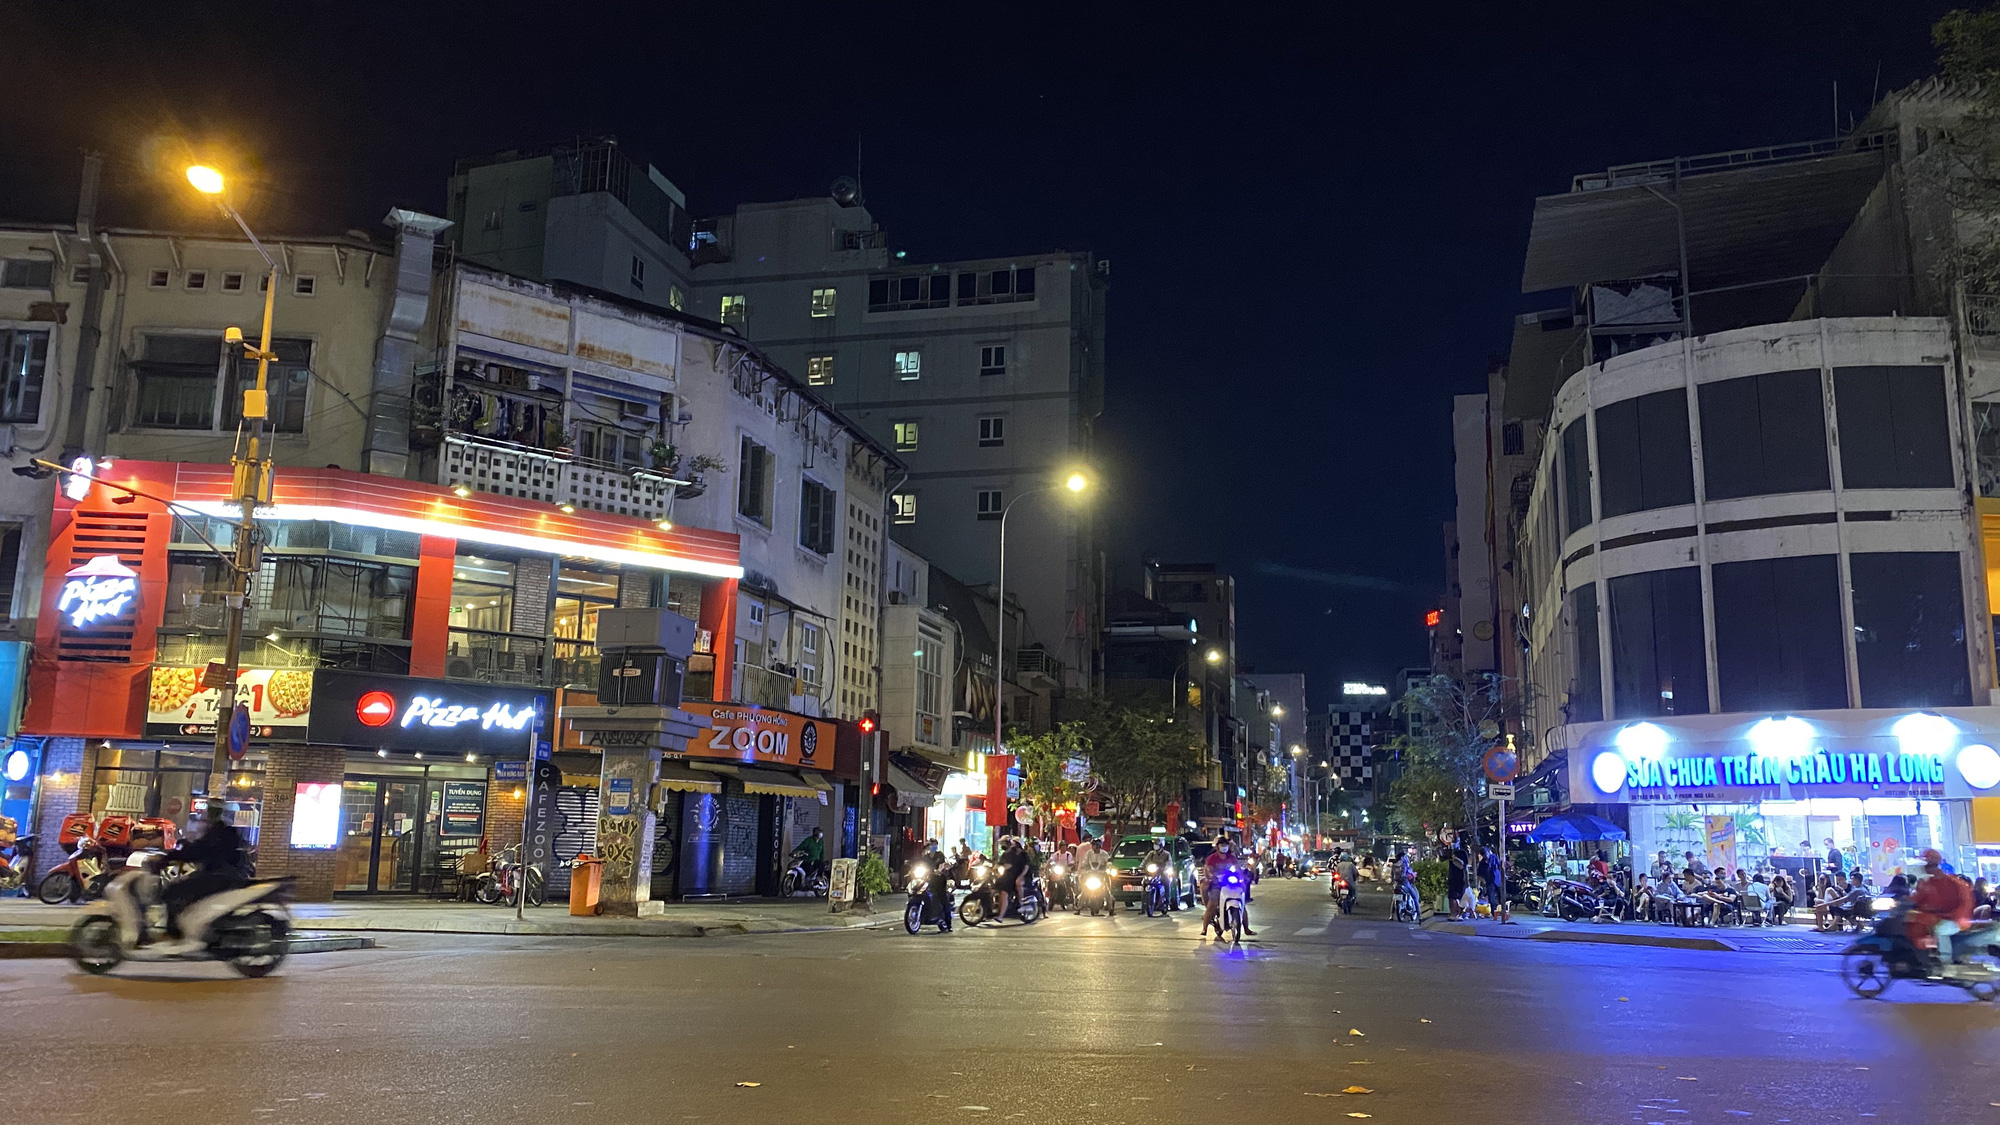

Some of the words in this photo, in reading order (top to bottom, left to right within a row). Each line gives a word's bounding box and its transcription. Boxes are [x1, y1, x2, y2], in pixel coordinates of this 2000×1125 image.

[59, 575, 136, 612] Pizza
[71, 593, 132, 628] Hut
[401, 697, 480, 729] Pizza
[482, 702, 536, 730] Hut
[712, 709, 735, 719] Cafe
[708, 725, 789, 756] ZOOM
[1785, 746, 1846, 785] CHÂU
[1849, 752, 1883, 790] HẠ
[1886, 751, 1944, 783] LONG
